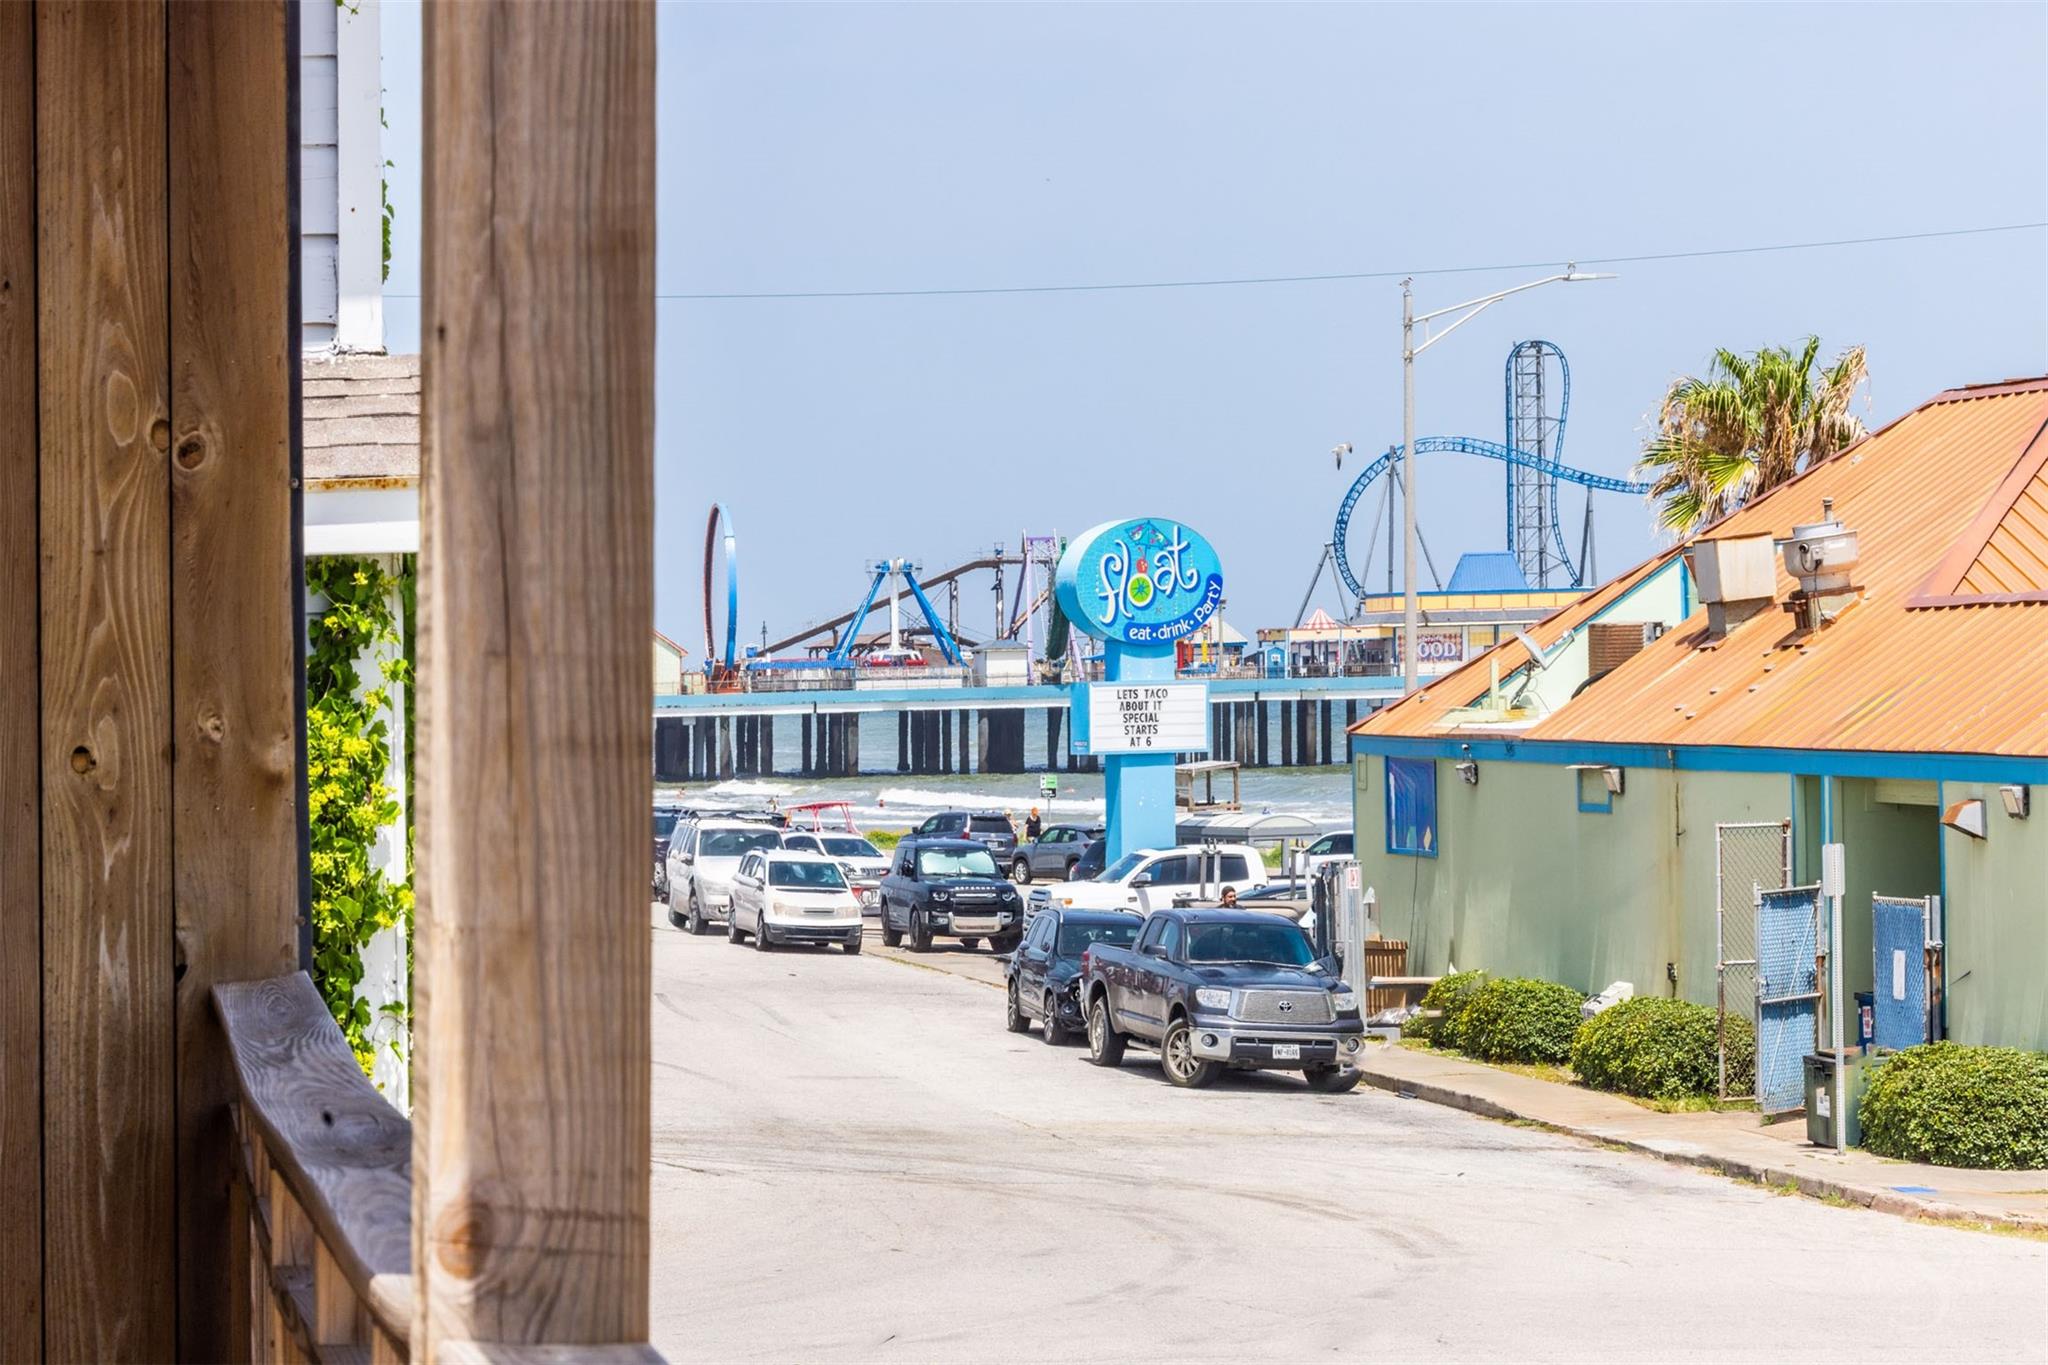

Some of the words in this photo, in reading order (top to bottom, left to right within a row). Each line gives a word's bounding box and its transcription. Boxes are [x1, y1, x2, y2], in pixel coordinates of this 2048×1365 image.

[1098, 525, 1199, 625] float
[1129, 626, 1152, 640] eat
[1157, 618, 1192, 639] drink
[1417, 641, 1456, 658] OOD
[1117, 689, 1139, 700] LETS
[1144, 688, 1168, 699] TACO
[1119, 701, 1149, 711] ABOUT
[1153, 701, 1162, 711] IT
[1123, 713, 1160, 723] SPECIAL
[1124, 724, 1159, 735] STARTS
[1130, 737, 1141, 747] AT
[1145, 736, 1152, 747] 6
